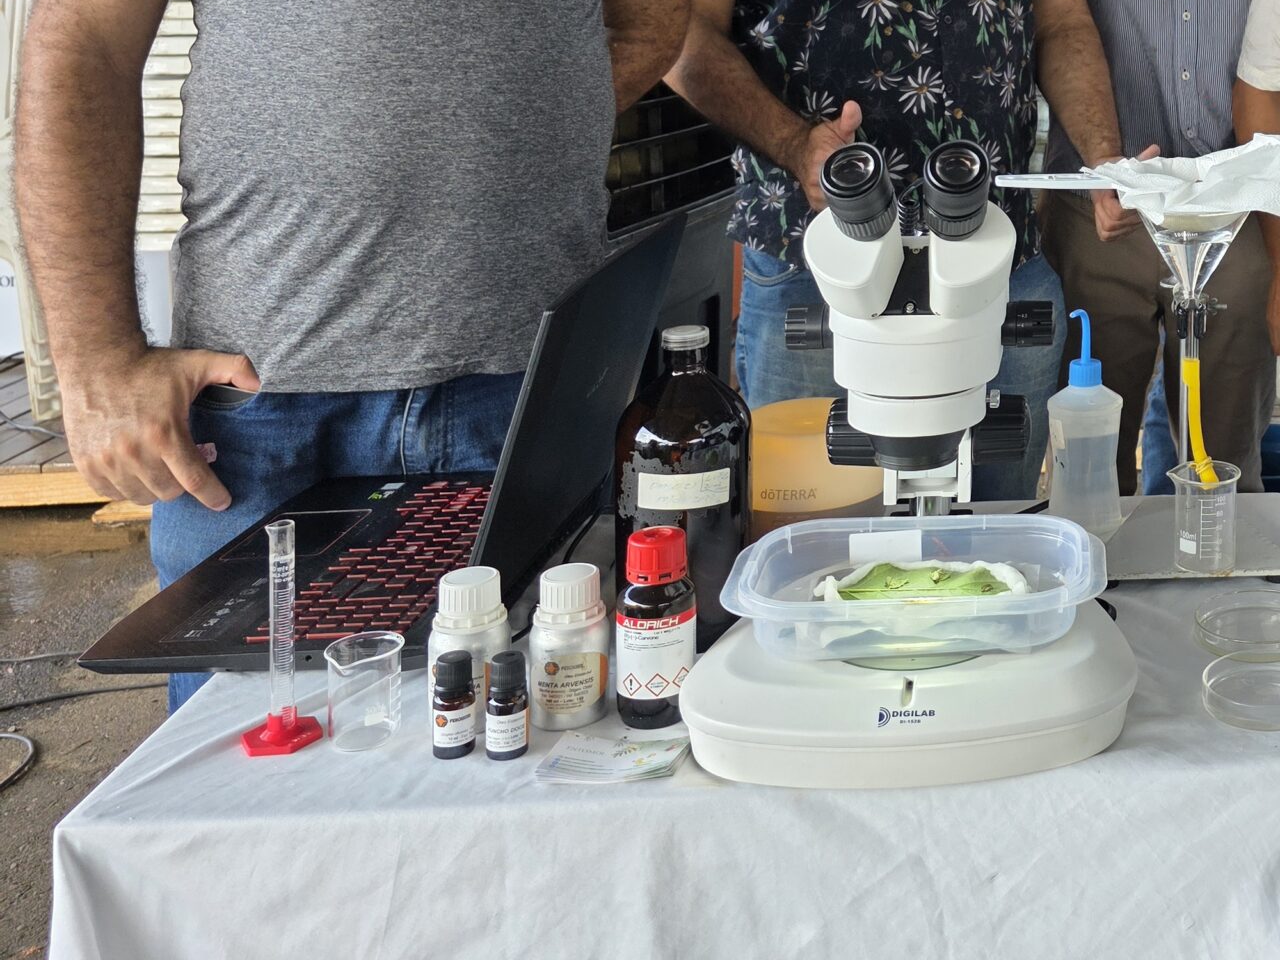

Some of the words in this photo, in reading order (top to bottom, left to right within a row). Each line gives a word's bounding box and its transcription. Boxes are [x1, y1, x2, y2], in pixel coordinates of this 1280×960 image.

[622, 616, 680, 629] ALDRICH
[538, 680, 559, 689] MENTA
[560, 676, 595, 689] ARVENSIS
[891, 709, 936, 718] DIGILAB
